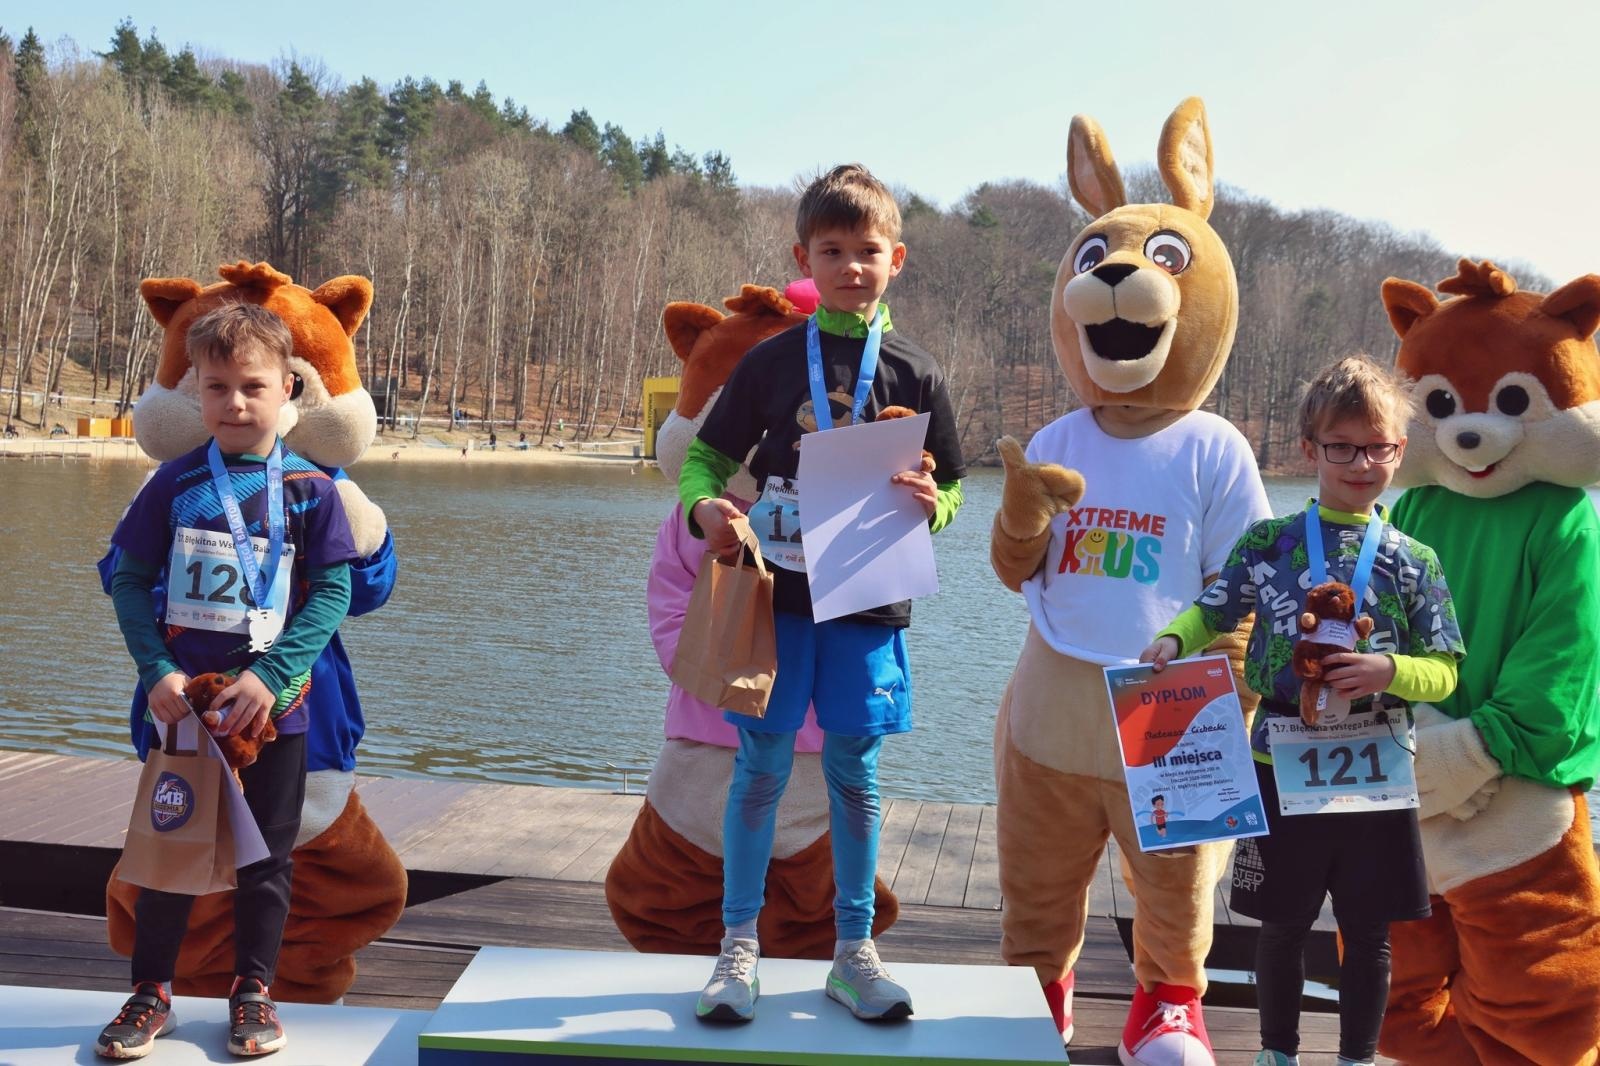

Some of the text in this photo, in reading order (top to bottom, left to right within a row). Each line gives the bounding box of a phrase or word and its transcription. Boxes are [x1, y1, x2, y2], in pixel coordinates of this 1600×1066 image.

[1066, 507, 1166, 537] XTREME
[1140, 686, 1206, 705] DYPLOM
[1152, 749, 1222, 768] III miejsca
[1299, 743, 1388, 787] 121
